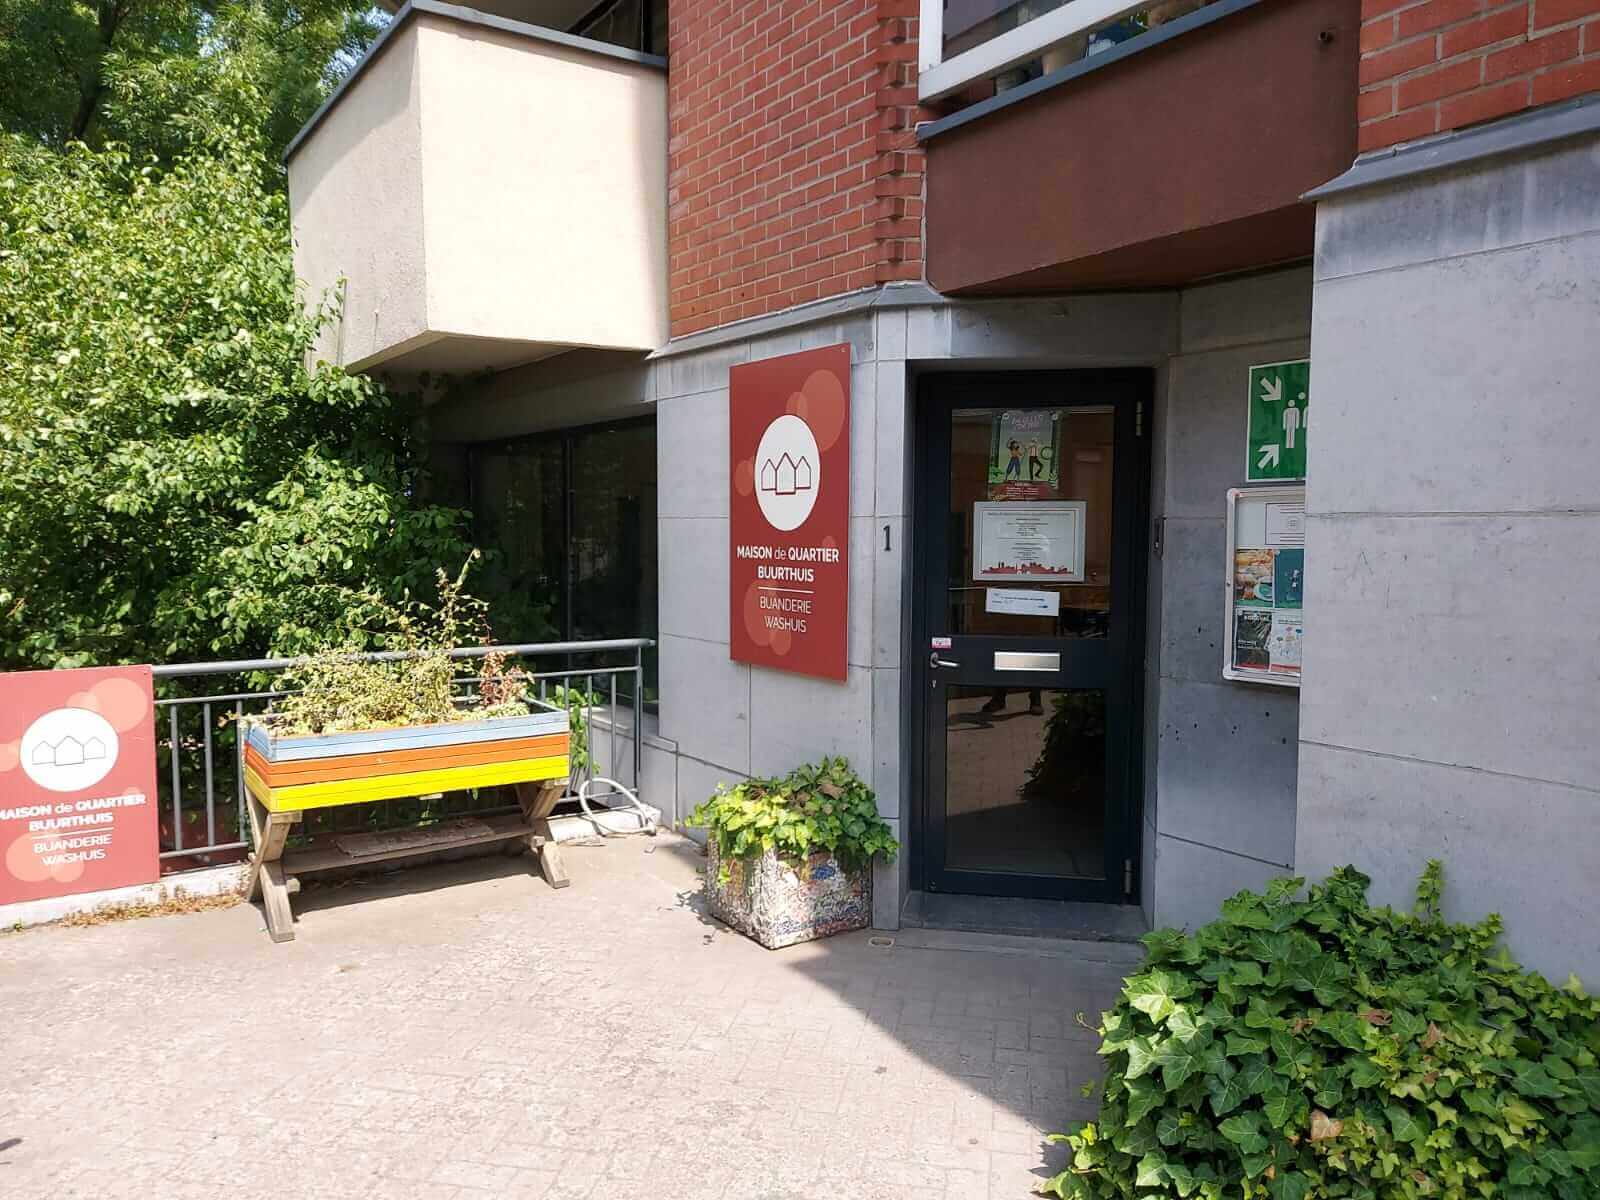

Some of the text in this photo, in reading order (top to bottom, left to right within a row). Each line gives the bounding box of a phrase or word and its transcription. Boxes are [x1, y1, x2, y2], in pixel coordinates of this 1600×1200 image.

[883, 524, 891, 551] 1
[736, 545, 840, 562] MAISON de QUARTIER
[757, 565, 814, 582] BUURTHUIS
[759, 596, 812, 614] BUANDERIE
[764, 615, 807, 633] WASHUIS
[55, 803, 74, 814] de
[75, 794, 146, 811] QUARTIER
[29, 812, 114, 832] BUURTHUIS
[33, 834, 112, 854] BUANDERIE
[42, 848, 106, 866] WASHUIS
